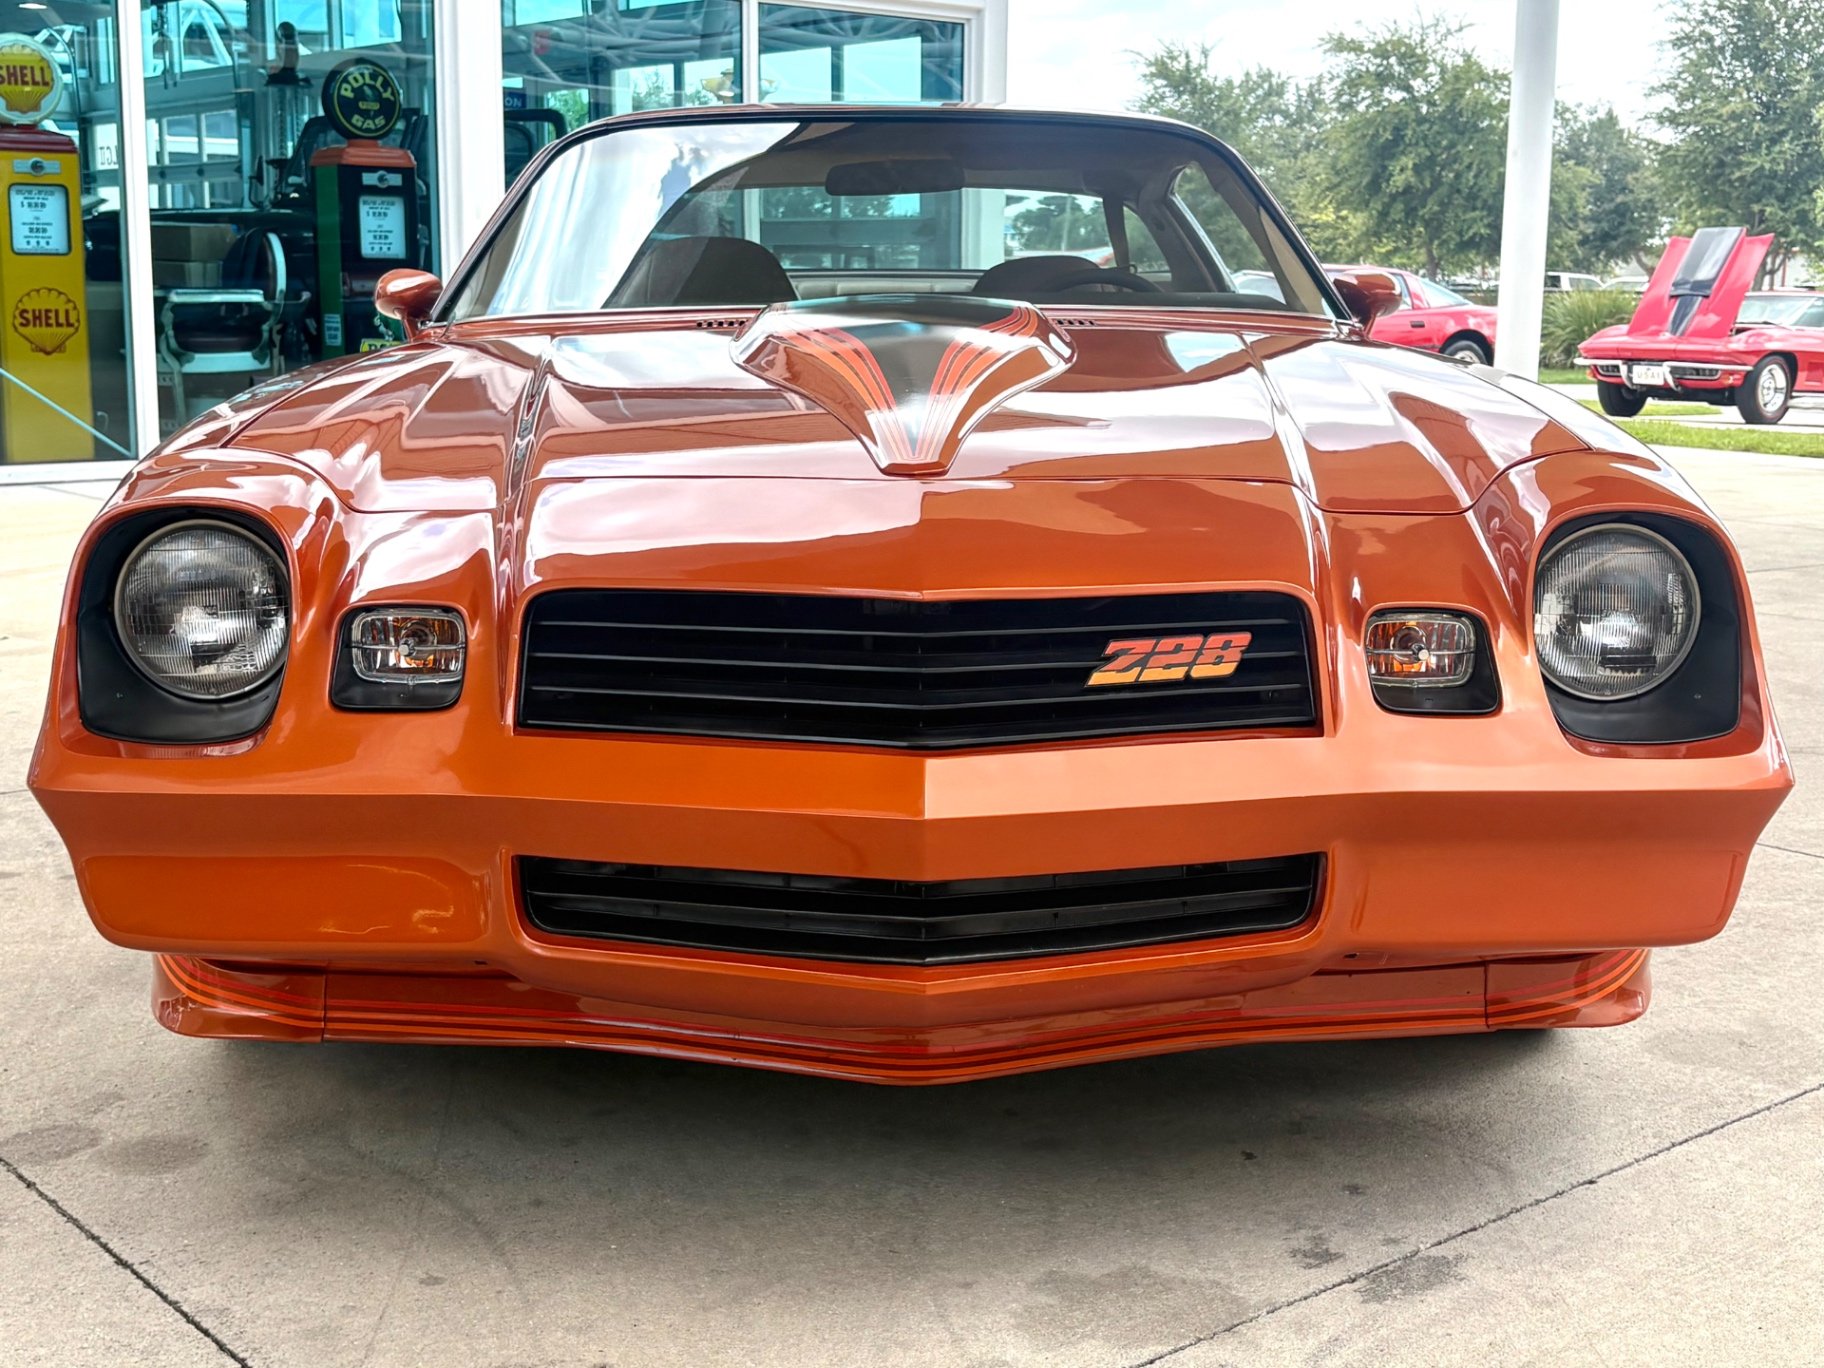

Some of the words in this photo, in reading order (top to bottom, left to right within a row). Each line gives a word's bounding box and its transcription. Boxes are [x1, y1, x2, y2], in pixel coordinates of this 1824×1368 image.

[340, 69, 395, 101] POLLY
[351, 113, 386, 130] GAS
[19, 308, 75, 328] SHELL
[1084, 631, 1252, 688] Z28
